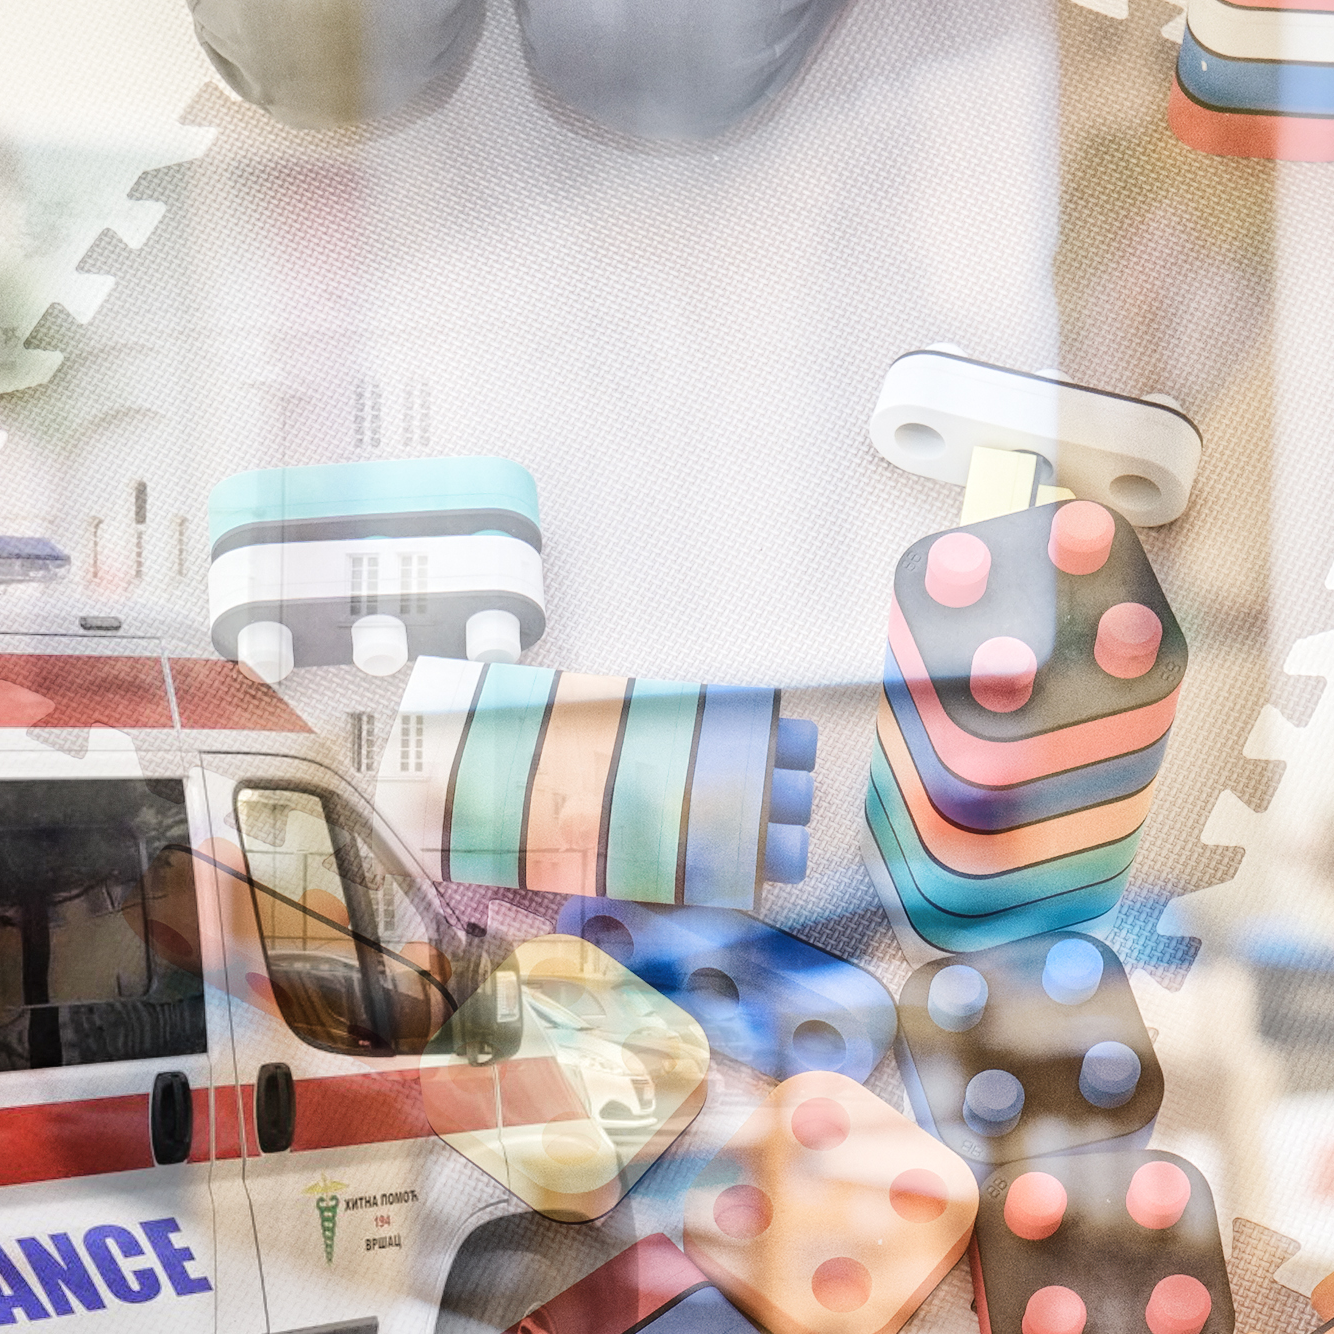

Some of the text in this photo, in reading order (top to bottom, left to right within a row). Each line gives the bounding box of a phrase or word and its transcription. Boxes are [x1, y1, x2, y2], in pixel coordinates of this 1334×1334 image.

[344, 1189, 419, 1212] ХИТНА ПОМОЋ
[374, 1214, 392, 1228] 194
[365, 1233, 403, 1251] ВРШАЦ
